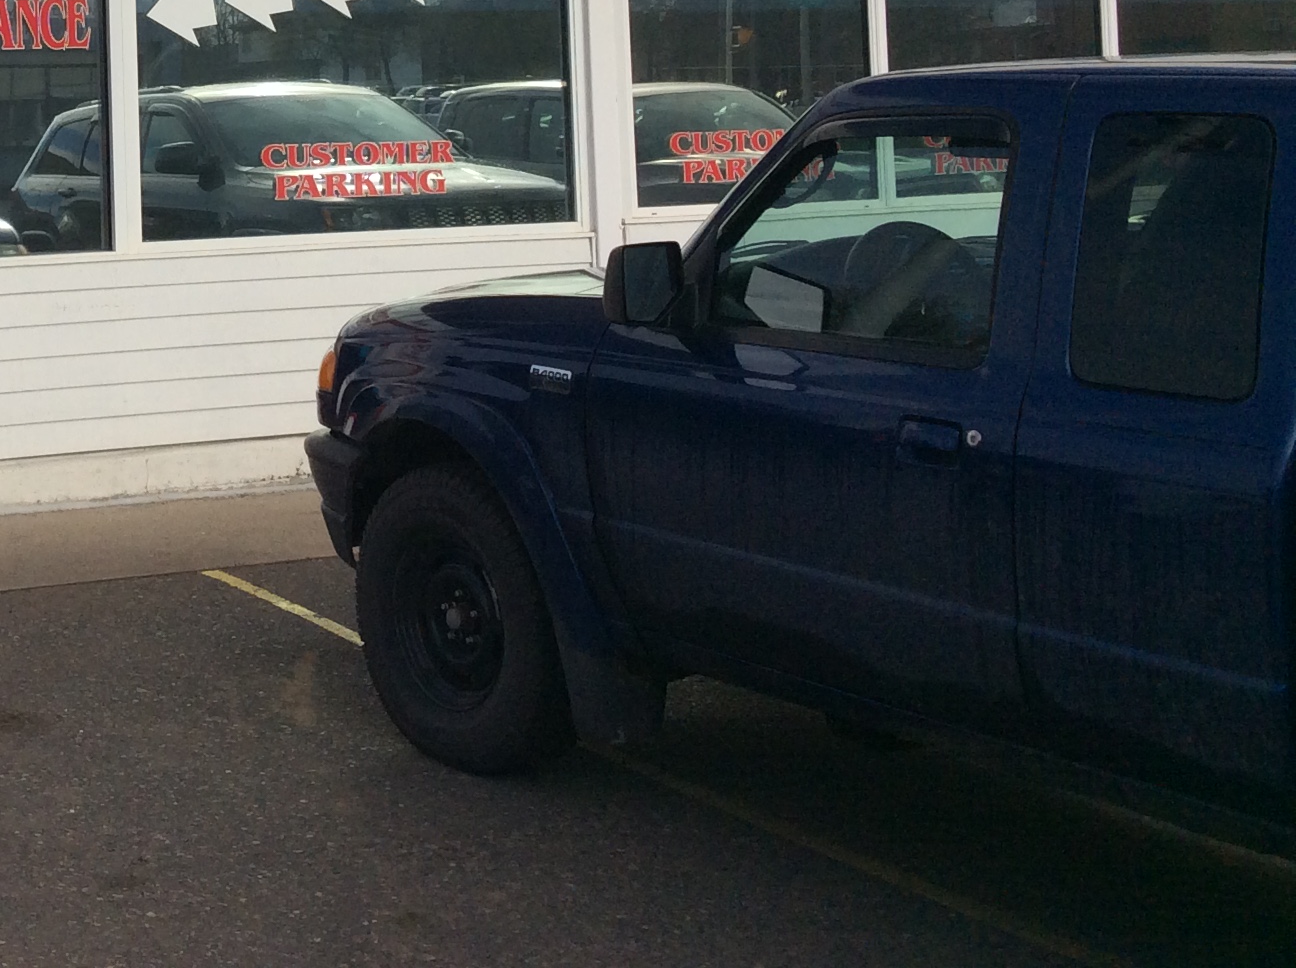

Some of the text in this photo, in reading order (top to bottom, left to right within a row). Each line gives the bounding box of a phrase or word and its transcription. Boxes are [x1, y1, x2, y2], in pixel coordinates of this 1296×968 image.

[260, 140, 454, 169] CUSTOMER
[669, 129, 786, 155] CUSTO
[274, 169, 447, 200] PARKING
